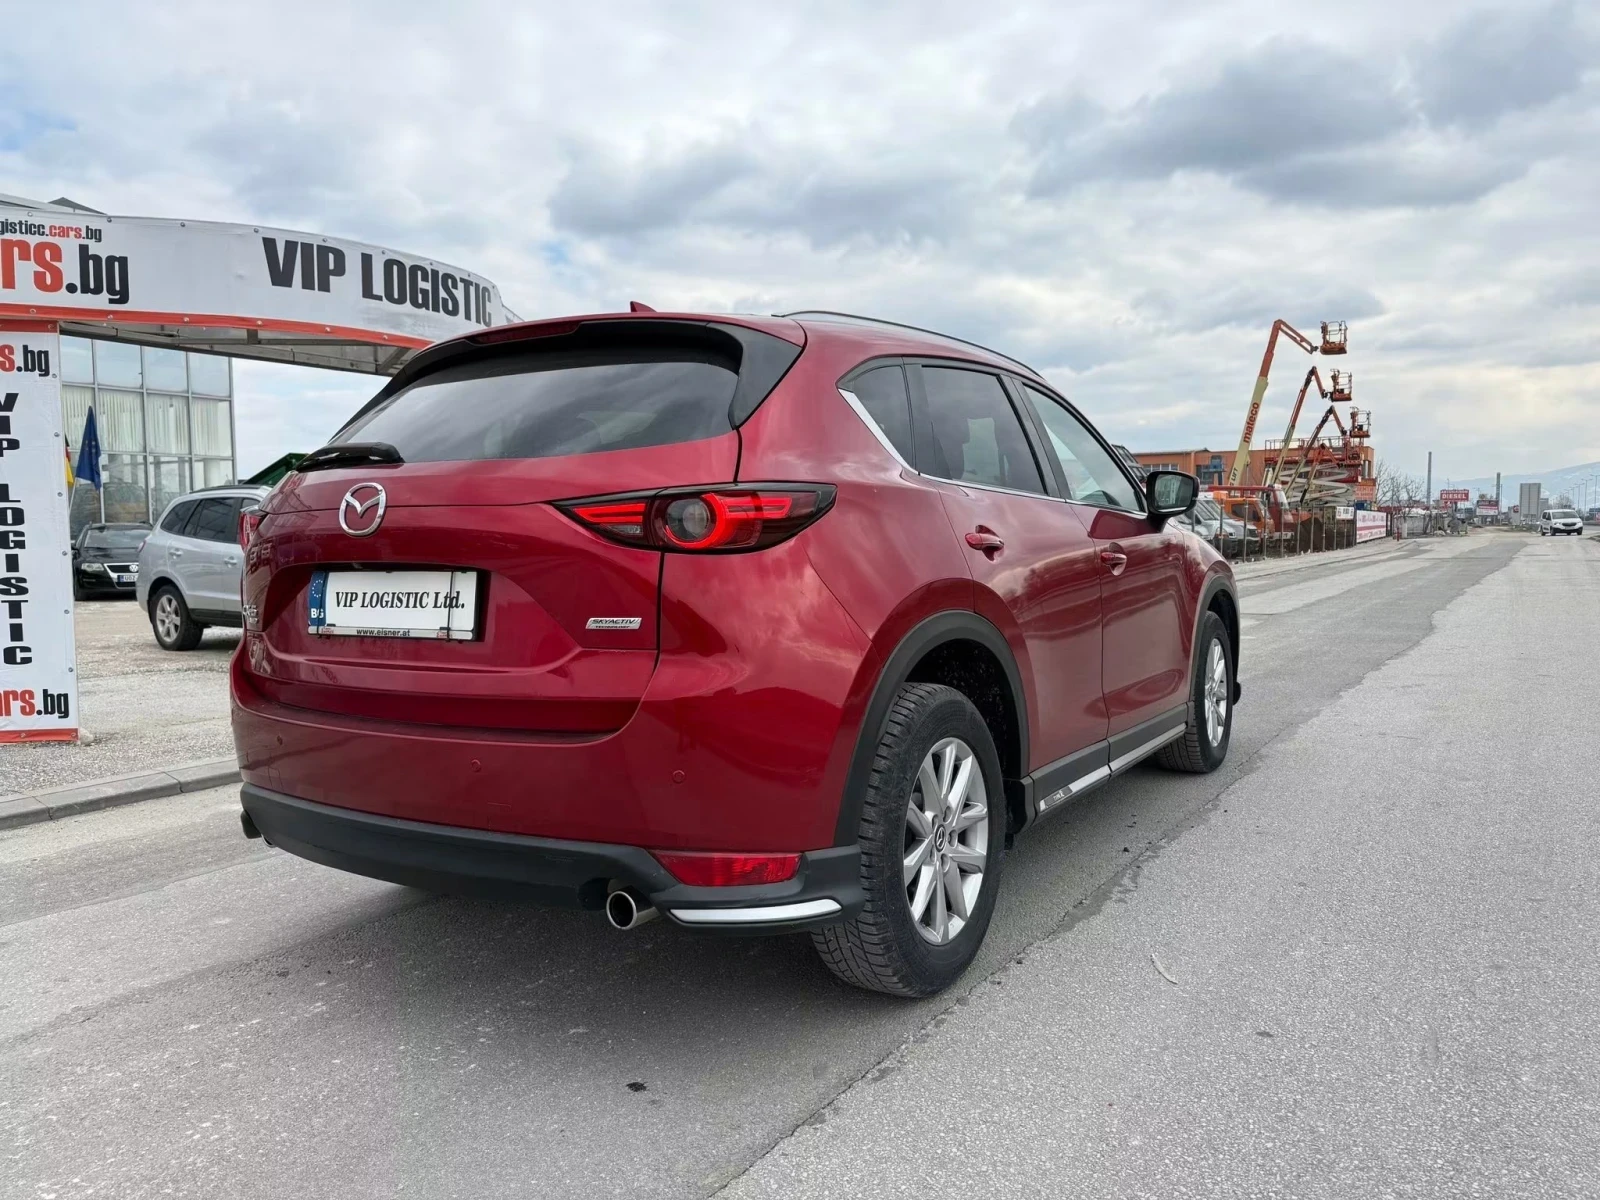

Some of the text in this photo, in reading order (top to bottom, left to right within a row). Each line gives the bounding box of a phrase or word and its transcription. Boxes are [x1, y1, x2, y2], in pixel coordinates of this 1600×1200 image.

[0, 239, 130, 304] rs.bg
[262, 237, 492, 328] VIP LOGISTIC
[1243, 402, 1260, 443] mateco
[1230, 467, 1239, 481] LIFT
[0, 483, 32, 665] LOGISTIC
[310, 608, 324, 619] BG
[335, 590, 465, 609] VIP LOGISTIC Ltd.
[356, 628, 411, 637] www.eisner.at
[0, 689, 70, 719] rs.bg
